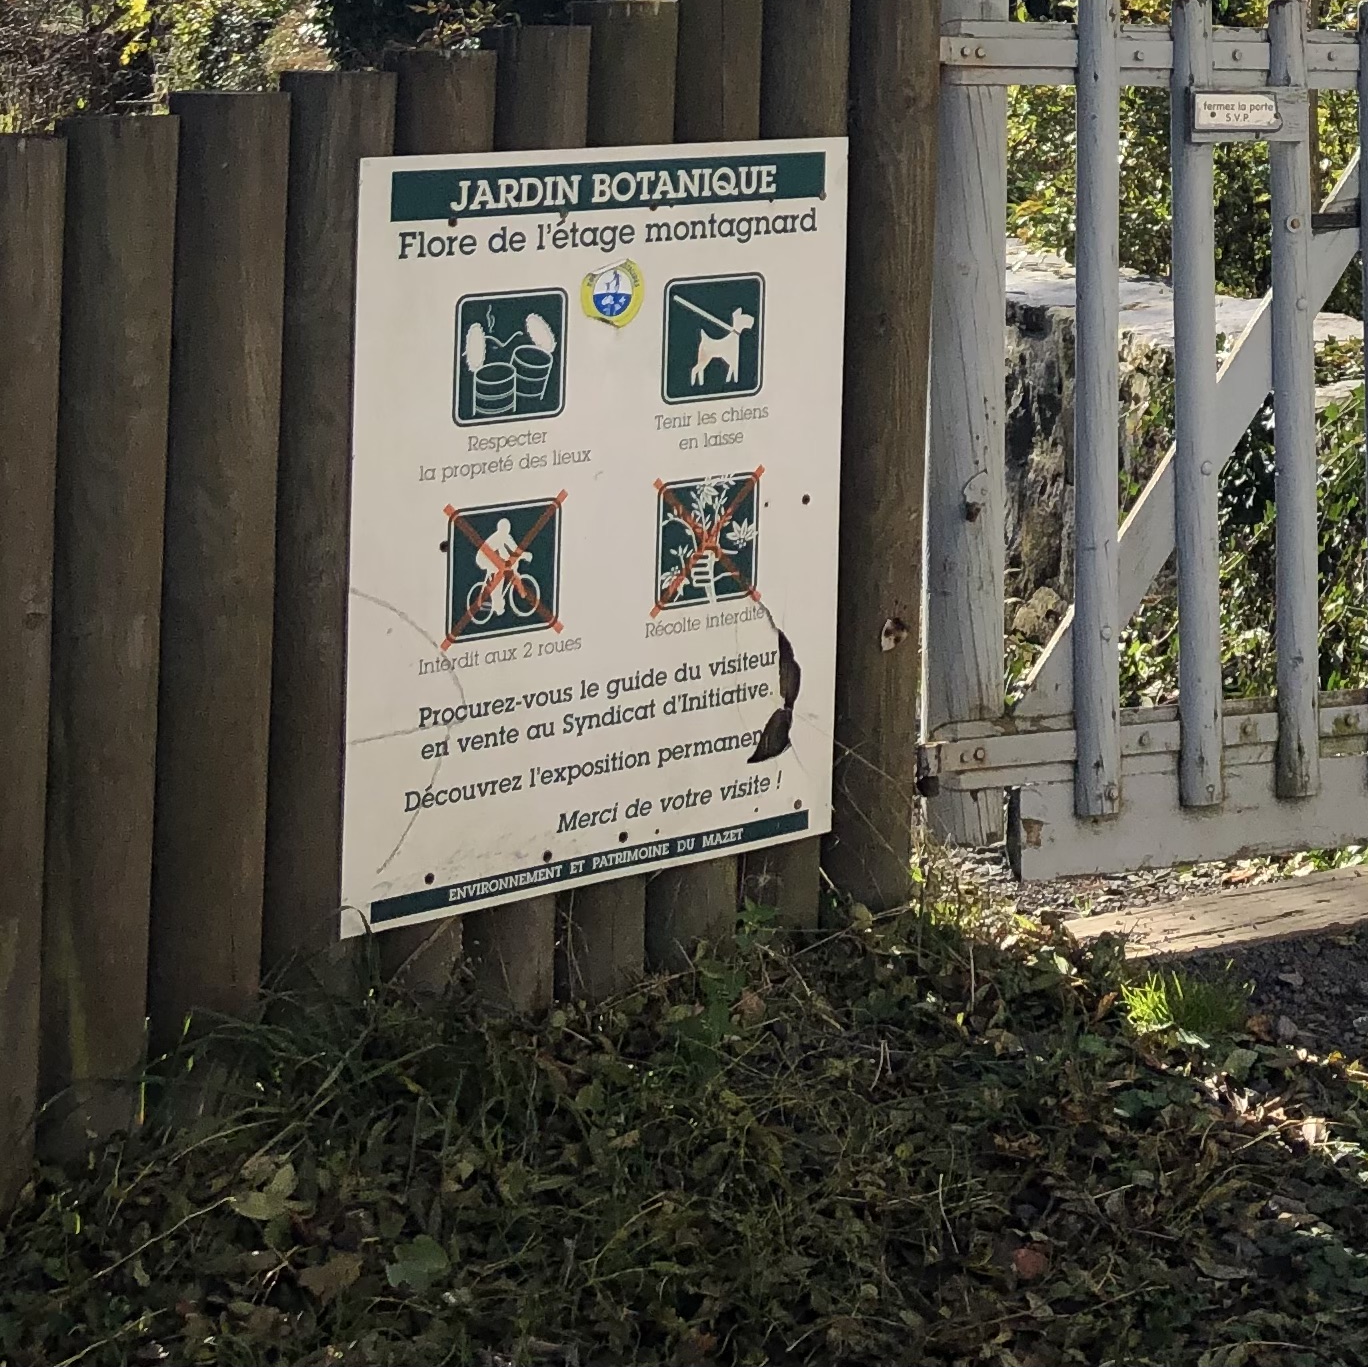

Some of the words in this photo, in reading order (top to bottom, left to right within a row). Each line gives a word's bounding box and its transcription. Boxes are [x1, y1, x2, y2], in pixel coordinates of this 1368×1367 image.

[1203, 100, 1235, 111] fermez
[1238, 101, 1247, 111] la
[1249, 102, 1274, 113] porte
[450, 174, 582, 212] JARDIN
[591, 165, 777, 205] BOTANIQUE
[398, 230, 477, 260] Flore
[488, 226, 526, 254] de
[536, 219, 635, 253] l'étage
[645, 208, 818, 244] montagnard
[654, 412, 692, 430] Tenir
[697, 410, 717, 426] les
[721, 405, 769, 422] chiens
[467, 430, 548, 452] Respecter
[678, 436, 699, 450] en
[703, 431, 744, 448] laisse
[418, 465, 436, 482] la
[441, 455, 514, 483] propreté
[518, 453, 548, 470] des
[552, 448, 592, 466] lieux
[645, 618, 701, 638] Récolte
[705, 606, 766, 631] interdite
[418, 651, 480, 675] Interdit
[484, 647, 518, 665] aux
[523, 641, 533, 659] 2
[537, 637, 582, 657] roues
[419, 687, 573, 728] Procurez-vous
[579, 680, 600, 702] le
[606, 668, 667, 700] guide
[674, 661, 702, 684] du
[709, 649, 779, 678] visiteur
[420, 742, 450, 761] en
[456, 728, 520, 753] vente
[526, 721, 556, 739] au
[563, 699, 656, 736] Syndicat
[663, 679, 774, 716] d'Initiative.
[403, 776, 523, 814] Découvrez
[530, 749, 650, 788] l'exposition
[658, 729, 764, 768] permanen
[557, 803, 619, 834] Merci
[625, 795, 652, 819] de
[660, 787, 713, 814] votre
[720, 773, 771, 802] visite
[776, 769, 783, 790] !
[448, 865, 563, 903] ENVIRONNEMENT
[569, 860, 586, 876] ET
[592, 842, 670, 871] PATRIMOINE
[676, 837, 696, 854] DU
[702, 827, 744, 848] MAZET
